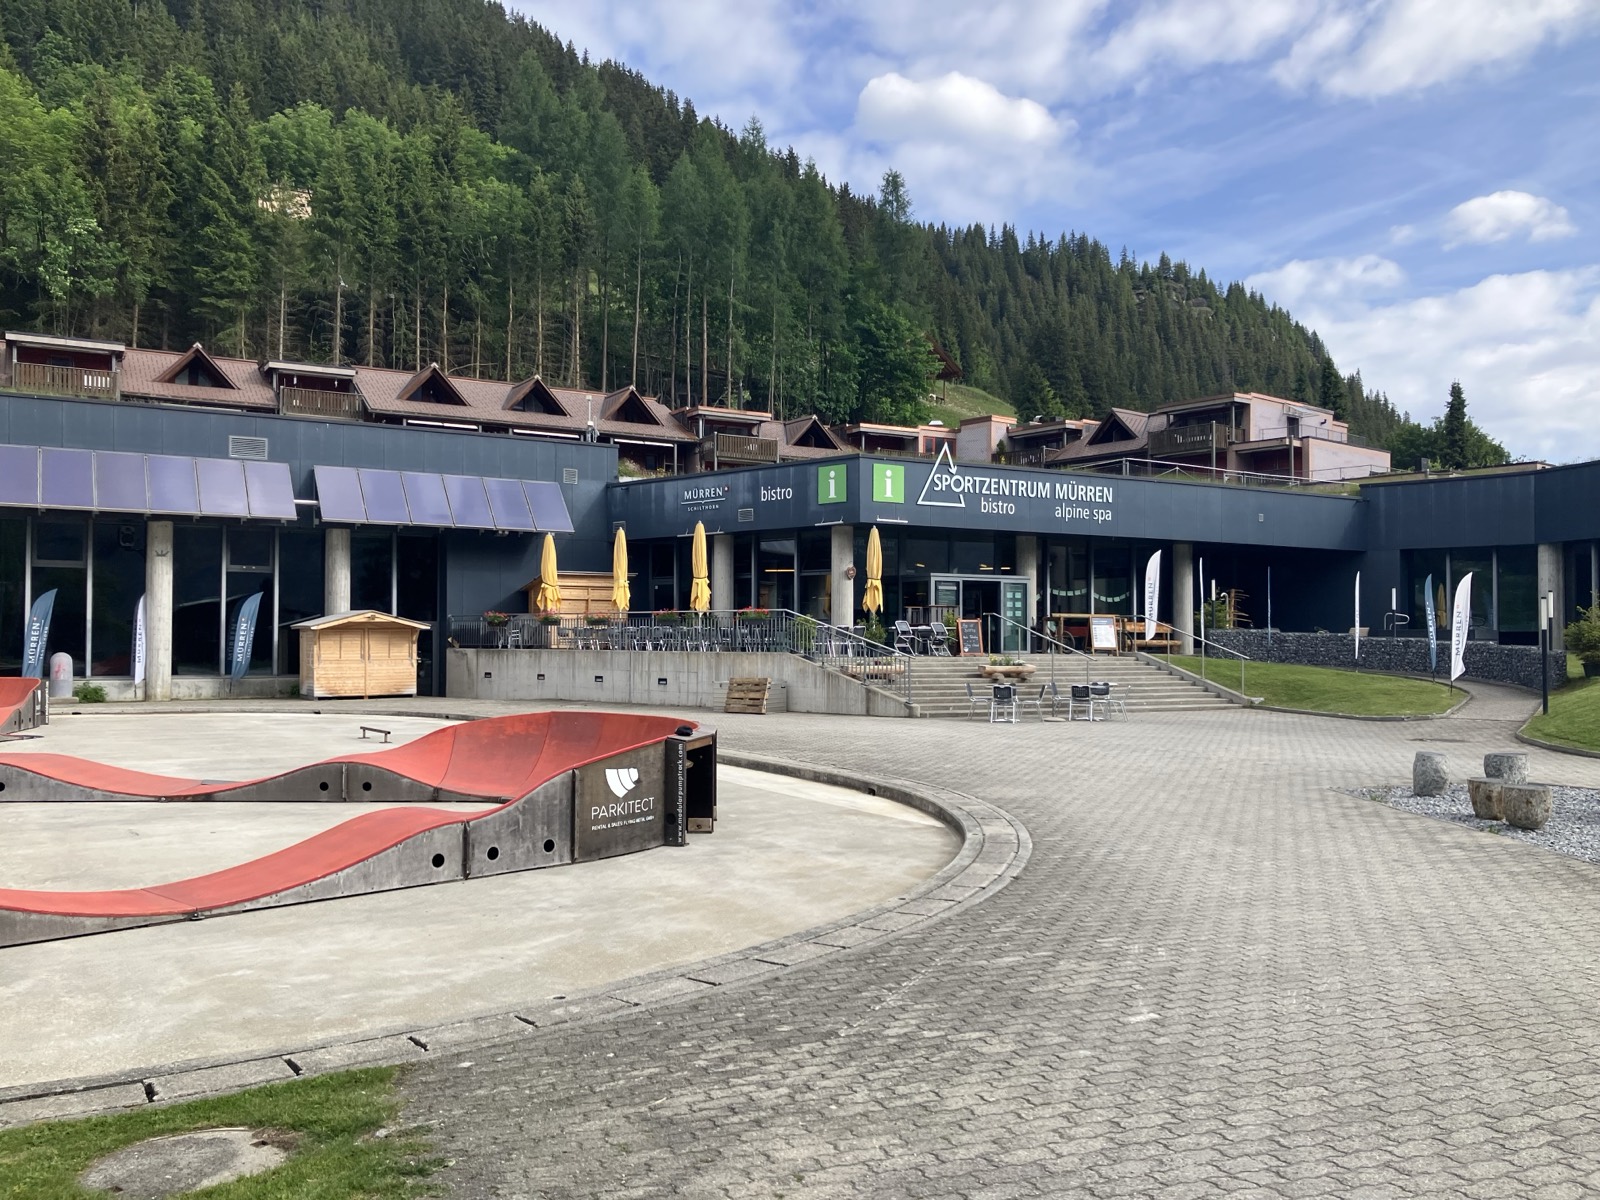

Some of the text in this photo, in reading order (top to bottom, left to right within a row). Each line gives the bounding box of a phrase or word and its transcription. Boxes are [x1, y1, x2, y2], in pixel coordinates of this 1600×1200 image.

[684, 486, 723, 500] MÜRREN
[760, 486, 793, 502] bistro
[933, 473, 1113, 503] SPORTZENTRUM MÜRREN
[687, 504, 720, 512] SCHILTHORN
[981, 496, 1015, 515] bistro
[1055, 502, 1112, 525] alpine spa
[591, 797, 655, 820] PARKITECT
